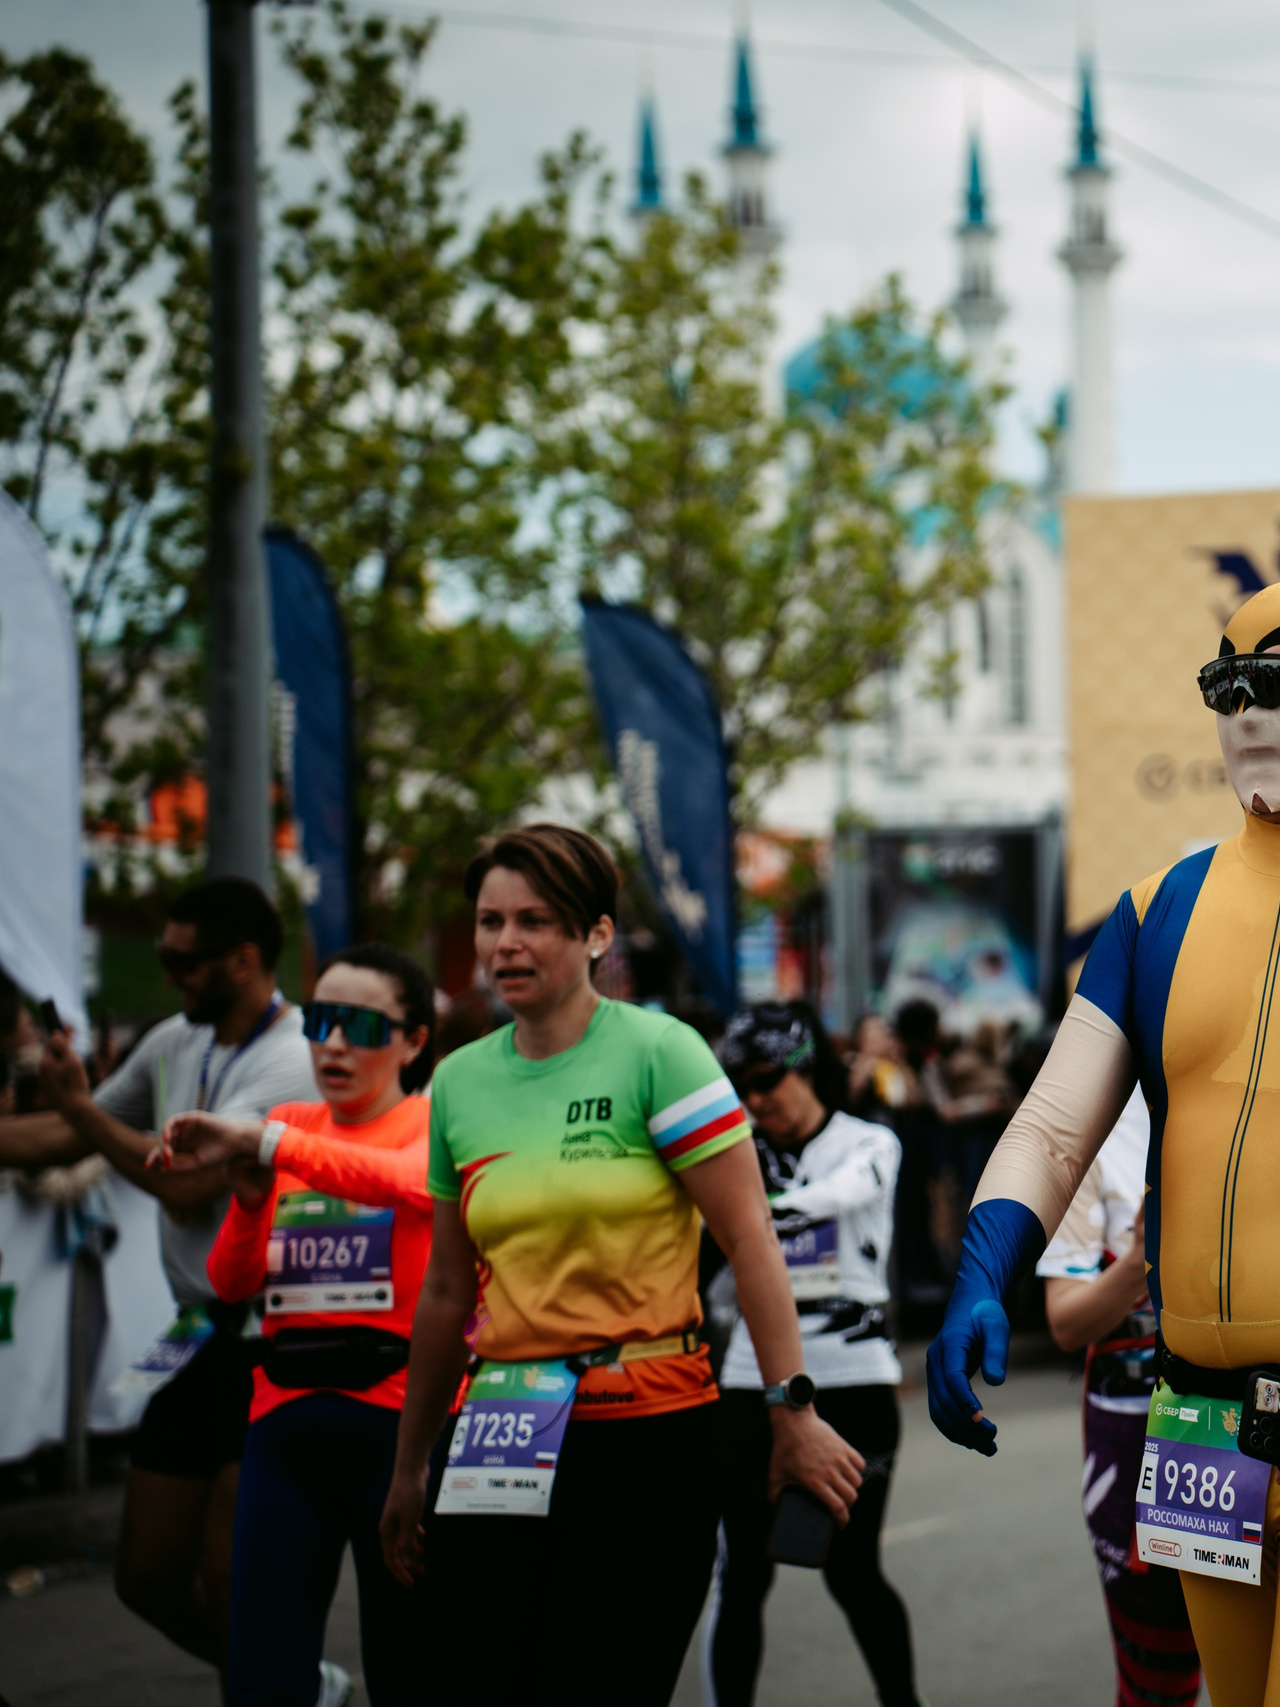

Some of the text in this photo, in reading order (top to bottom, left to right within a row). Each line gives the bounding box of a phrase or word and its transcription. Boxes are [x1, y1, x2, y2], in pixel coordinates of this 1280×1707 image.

[288, 1235, 370, 1270] 10267
[1163, 1406, 1179, 1416] СБЕР
[471, 1411, 536, 1448] 7235
[1145, 1441, 1159, 1453] 2025
[1142, 1459, 1236, 1511] E 9386
[1147, 1508, 1230, 1535] РОССОМАХА НАХ
[1151, 1541, 1173, 1553] Winline
